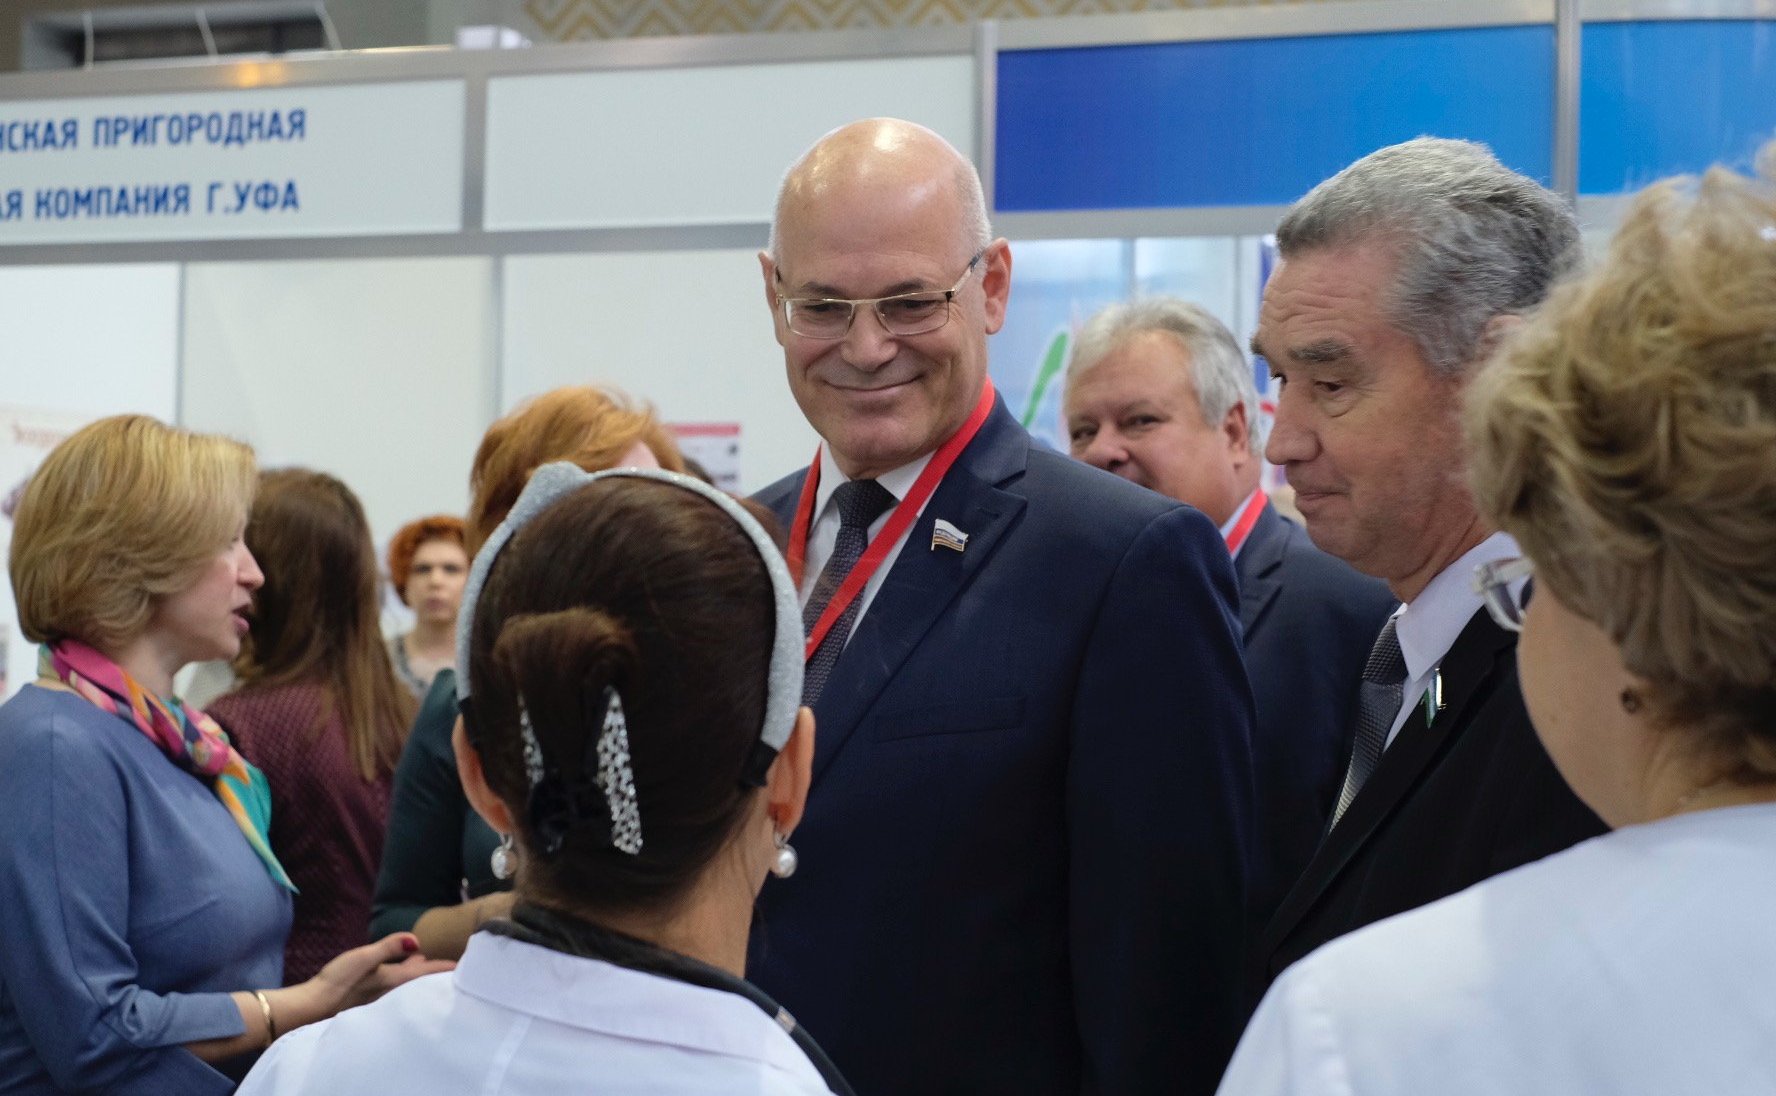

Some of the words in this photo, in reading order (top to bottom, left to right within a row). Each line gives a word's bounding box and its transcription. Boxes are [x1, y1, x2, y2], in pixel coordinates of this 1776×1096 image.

[93, 108, 306, 147] ПРИГОРОДНАЯ
[0, 189, 23, 221] Я
[34, 183, 191, 219] КОМПАНИЯ
[206, 179, 300, 214] Г.УФА
